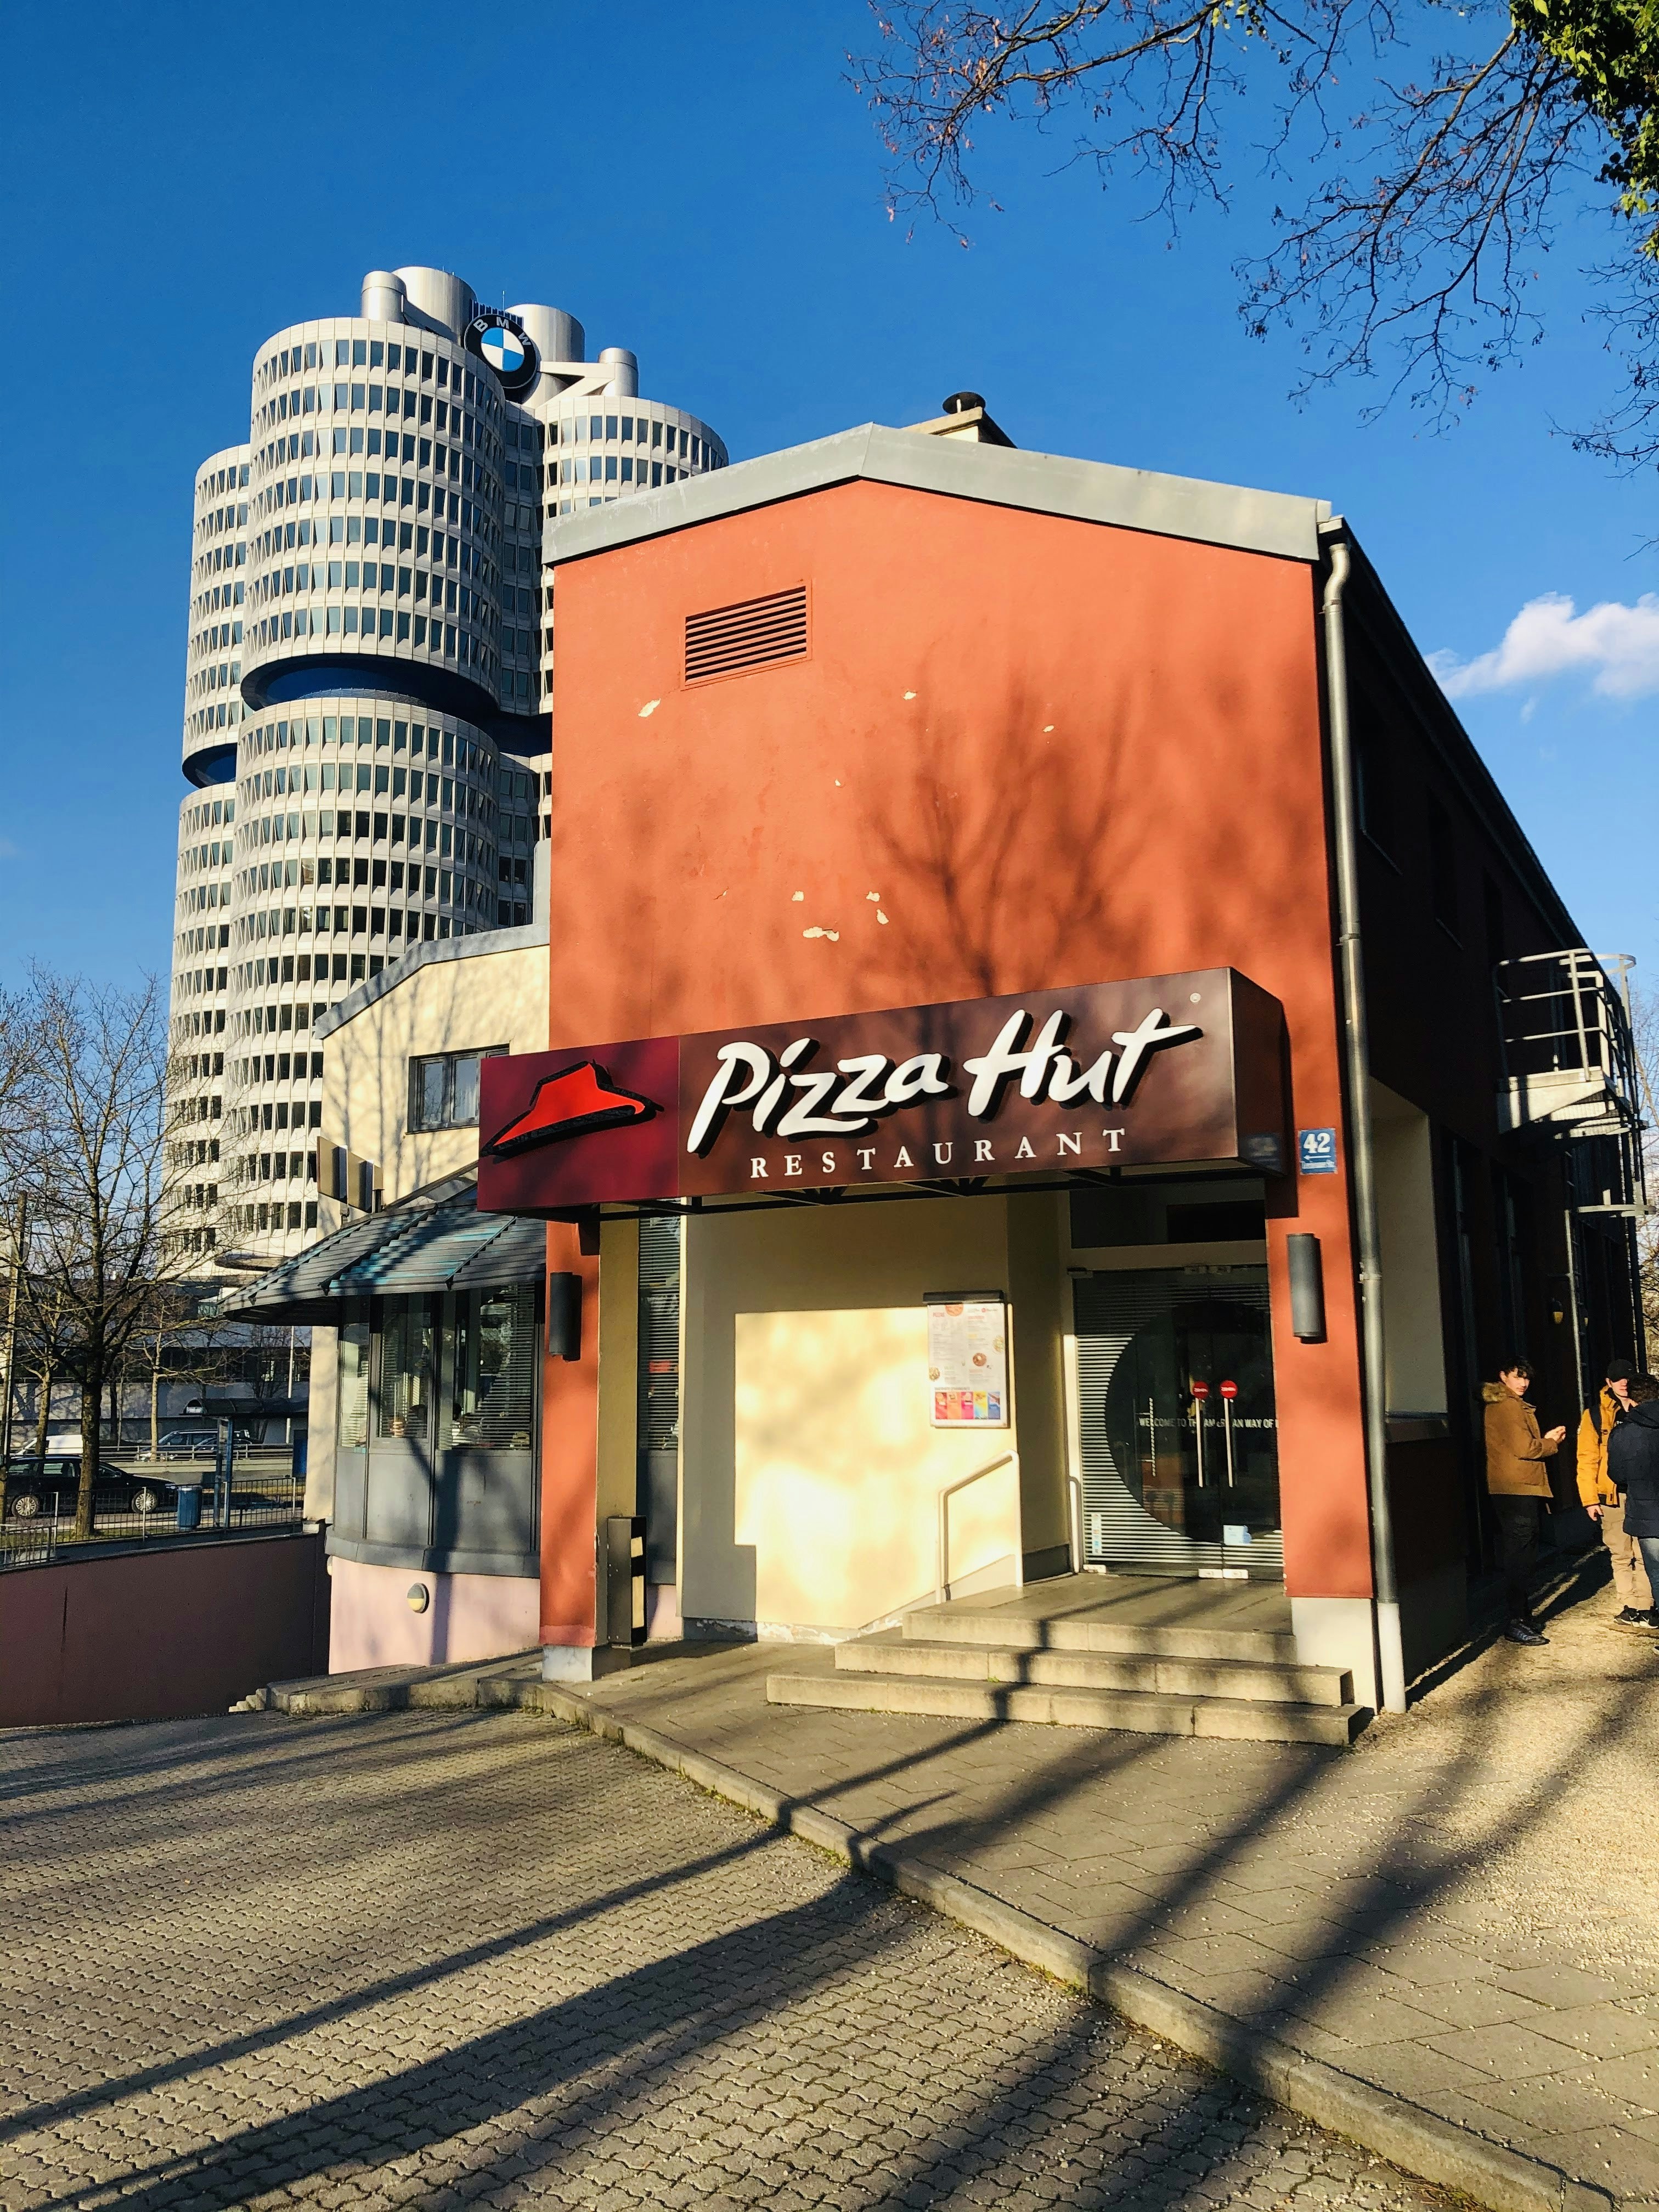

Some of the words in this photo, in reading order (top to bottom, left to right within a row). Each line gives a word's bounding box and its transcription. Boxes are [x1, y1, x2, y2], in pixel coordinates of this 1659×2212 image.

[473, 316, 532, 346] BMW
[687, 1037, 950, 1153] Pizza
[962, 1008, 1198, 1116] Hut
[750, 1128, 1125, 1178] RESTAURANT
[1303, 1132, 1331, 1154] 42
[1244, 1419, 1262, 1428] WAY
[1263, 1418, 1274, 1429] OF
